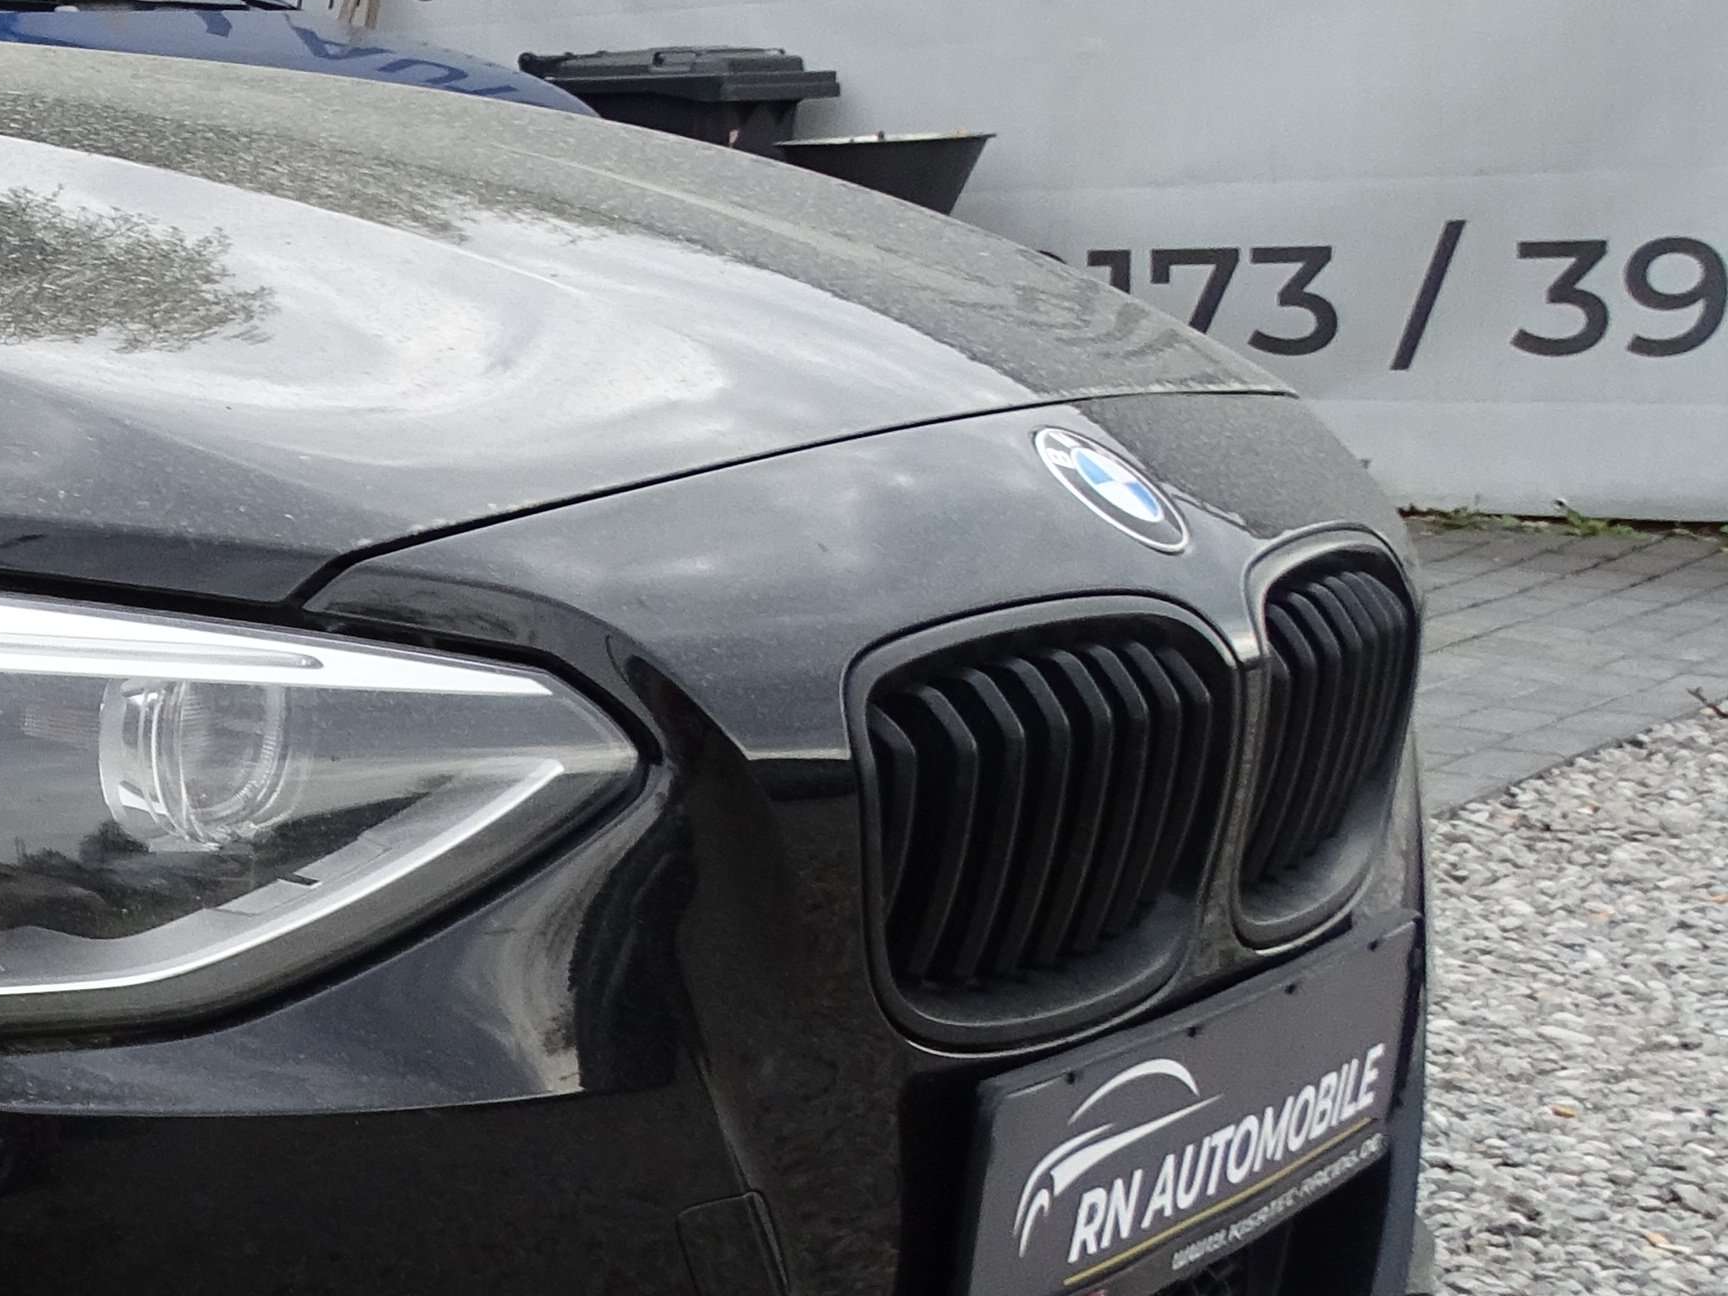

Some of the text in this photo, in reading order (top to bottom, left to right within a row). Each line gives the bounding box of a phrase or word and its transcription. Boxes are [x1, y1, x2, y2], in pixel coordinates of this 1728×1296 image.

[1037, 219, 1728, 371] 173 / 39
[1067, 1169, 1143, 1263] RN
[1141, 1043, 1385, 1230] AUTOMOBILE
